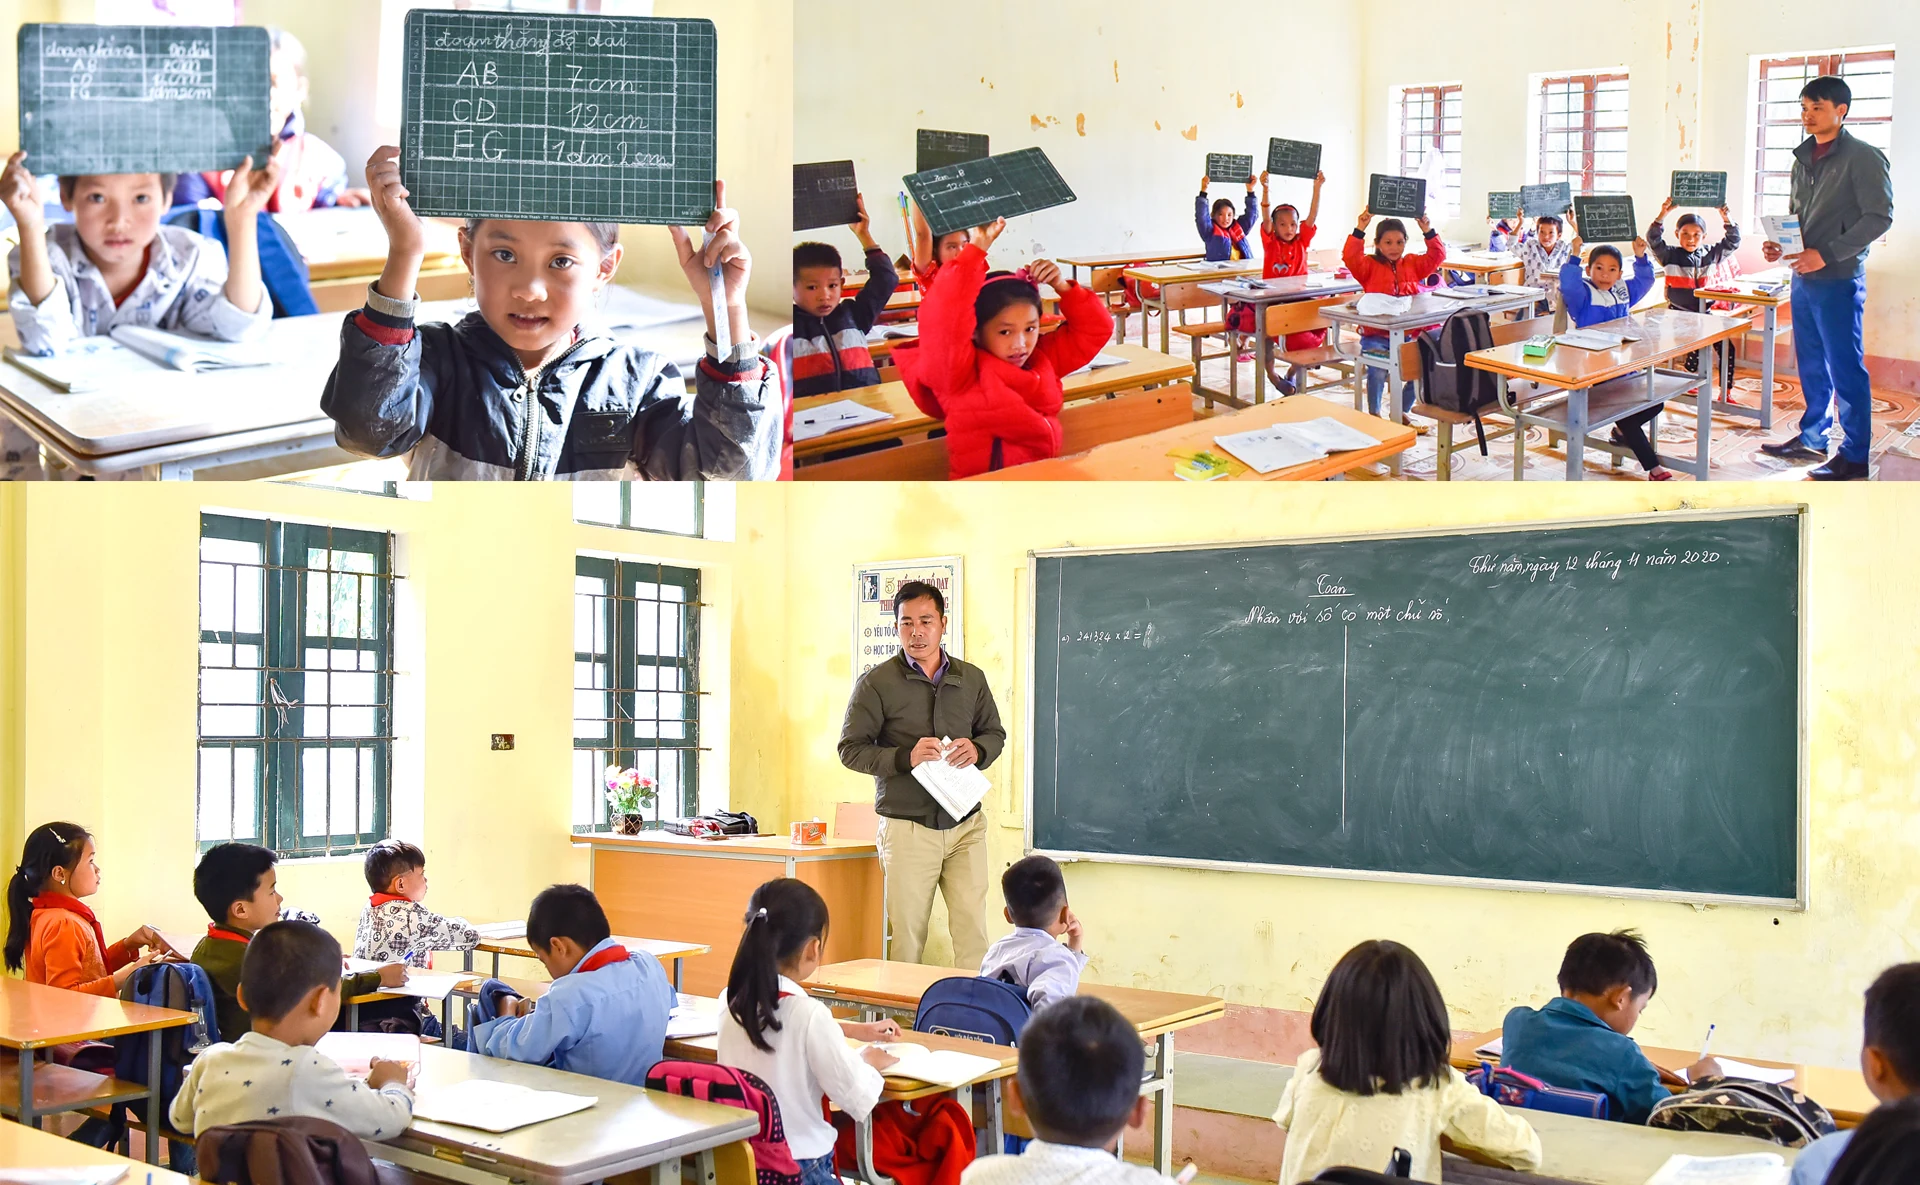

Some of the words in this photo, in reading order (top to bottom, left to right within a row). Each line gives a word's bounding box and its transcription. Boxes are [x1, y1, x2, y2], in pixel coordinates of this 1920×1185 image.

[456, 60, 499, 86] AB
[453, 97, 496, 122] CD
[1469, 554, 1499, 574] Thứ
[1565, 556, 1579, 571] 12
[1585, 550, 1621, 580] tháng
[1645, 548, 1677, 566] năm
[1680, 550, 1720, 564] 2020
[1316, 573, 1347, 594] Toán
[1244, 605, 1281, 624] Nhân
[1288, 603, 1311, 624] với
[1341, 603, 1362, 621] có
[1366, 605, 1391, 626] một
